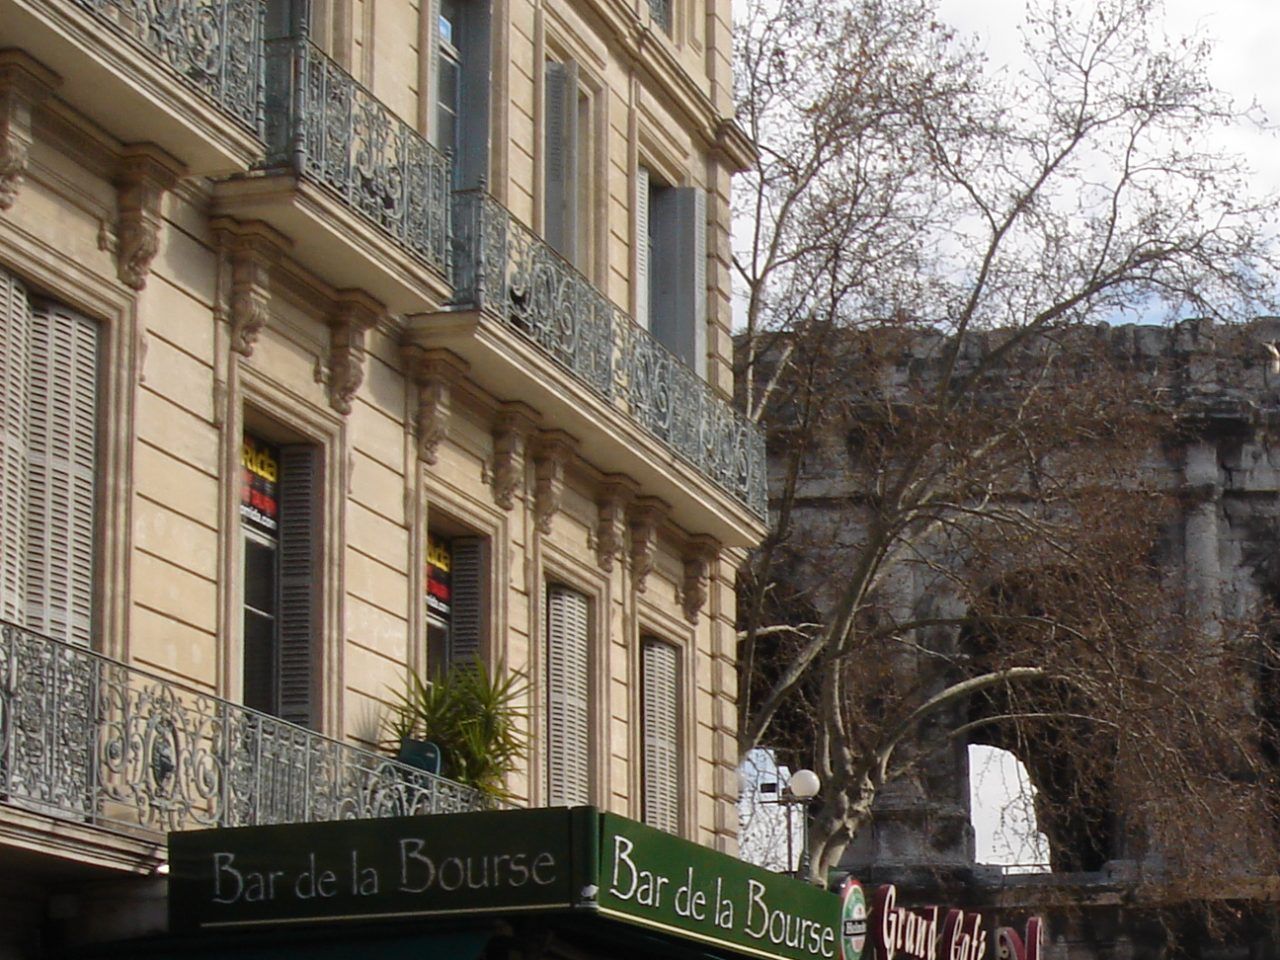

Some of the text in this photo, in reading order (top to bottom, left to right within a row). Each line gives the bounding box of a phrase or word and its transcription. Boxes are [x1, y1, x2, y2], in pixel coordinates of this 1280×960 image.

[213, 837, 557, 904] Bar de la Bourse
[609, 834, 835, 958] Bar de la Bourse
